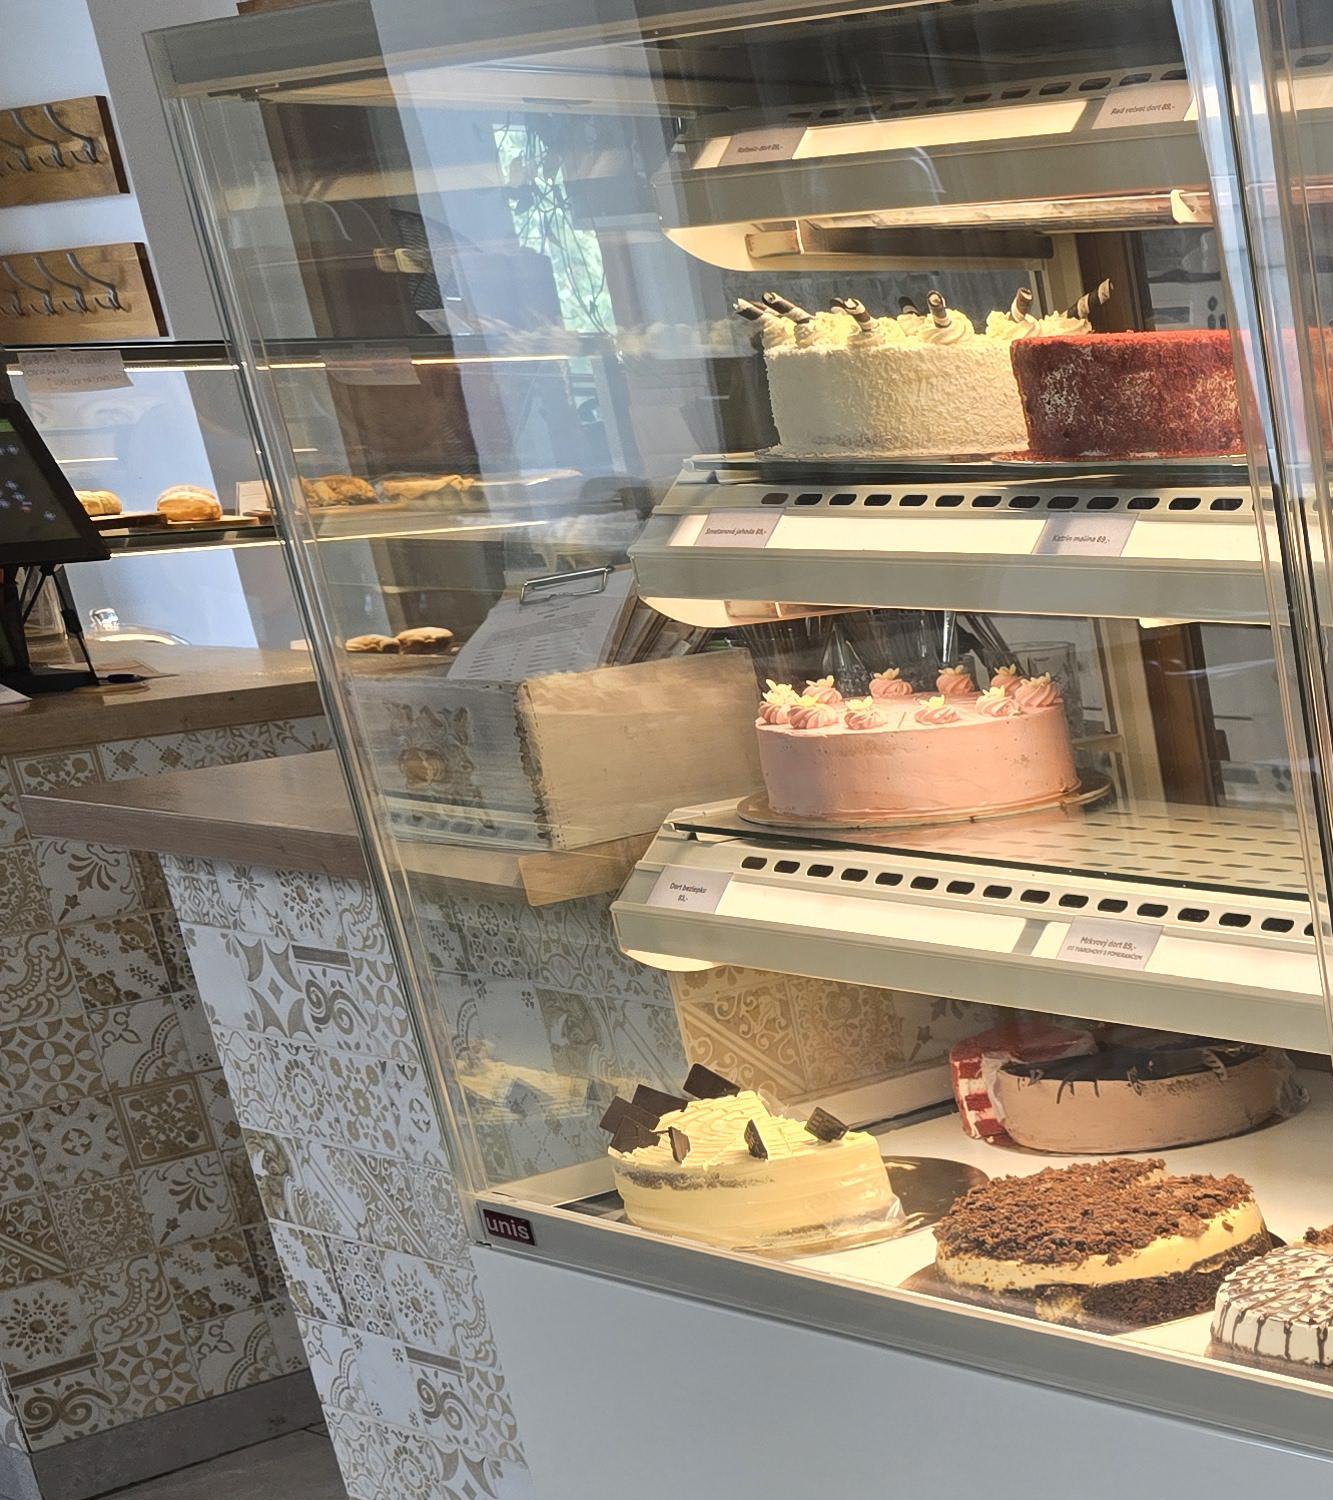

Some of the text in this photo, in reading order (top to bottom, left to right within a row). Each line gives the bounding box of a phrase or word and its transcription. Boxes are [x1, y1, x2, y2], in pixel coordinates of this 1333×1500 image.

[1111, 107, 1126, 115] Red
[1147, 104, 1162, 112] dort
[1080, 936, 1107, 948] Mrkvový
[1107, 940, 1123, 949] dort
[486, 1216, 530, 1240] unis
